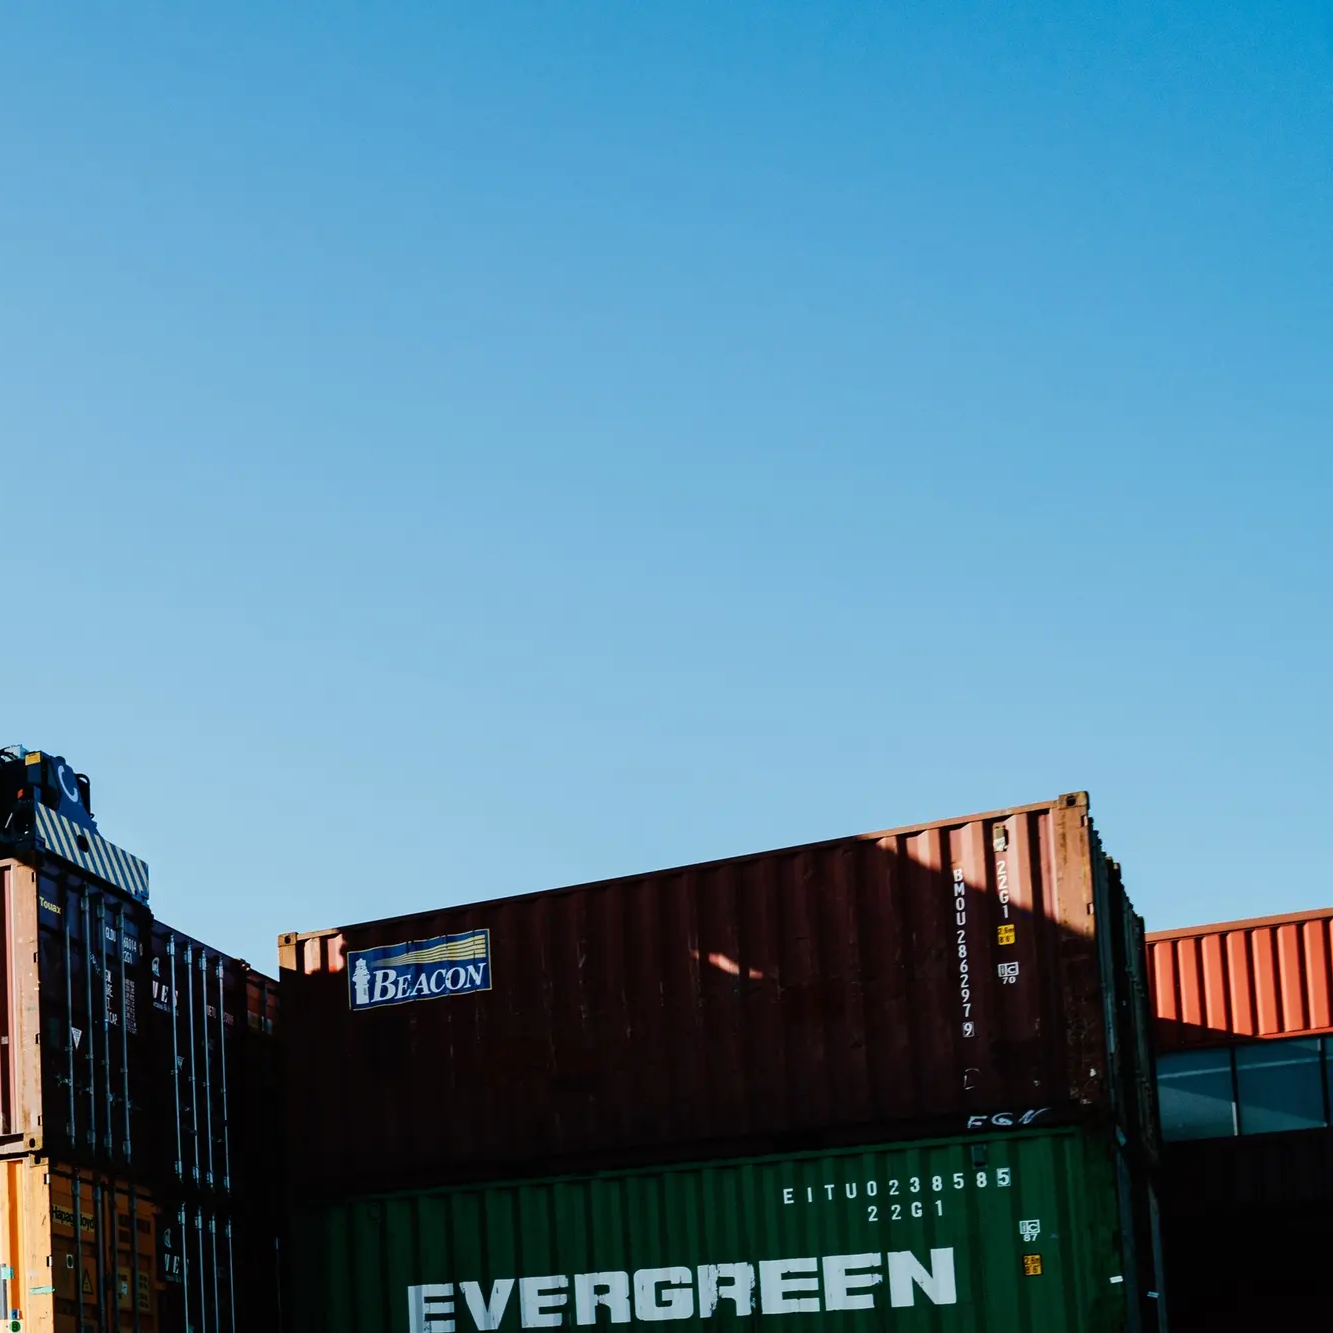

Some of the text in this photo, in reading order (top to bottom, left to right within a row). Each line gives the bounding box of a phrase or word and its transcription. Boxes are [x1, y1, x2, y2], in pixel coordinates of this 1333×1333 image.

[996, 860, 1009, 919] 22G1
[39, 896, 62, 915] Touax
[953, 868, 974, 1037] BMOU 286297 9
[1002, 976, 1016, 984] 70
[867, 1200, 944, 1222] 22G1
[1023, 1234, 1038, 1242] 87
